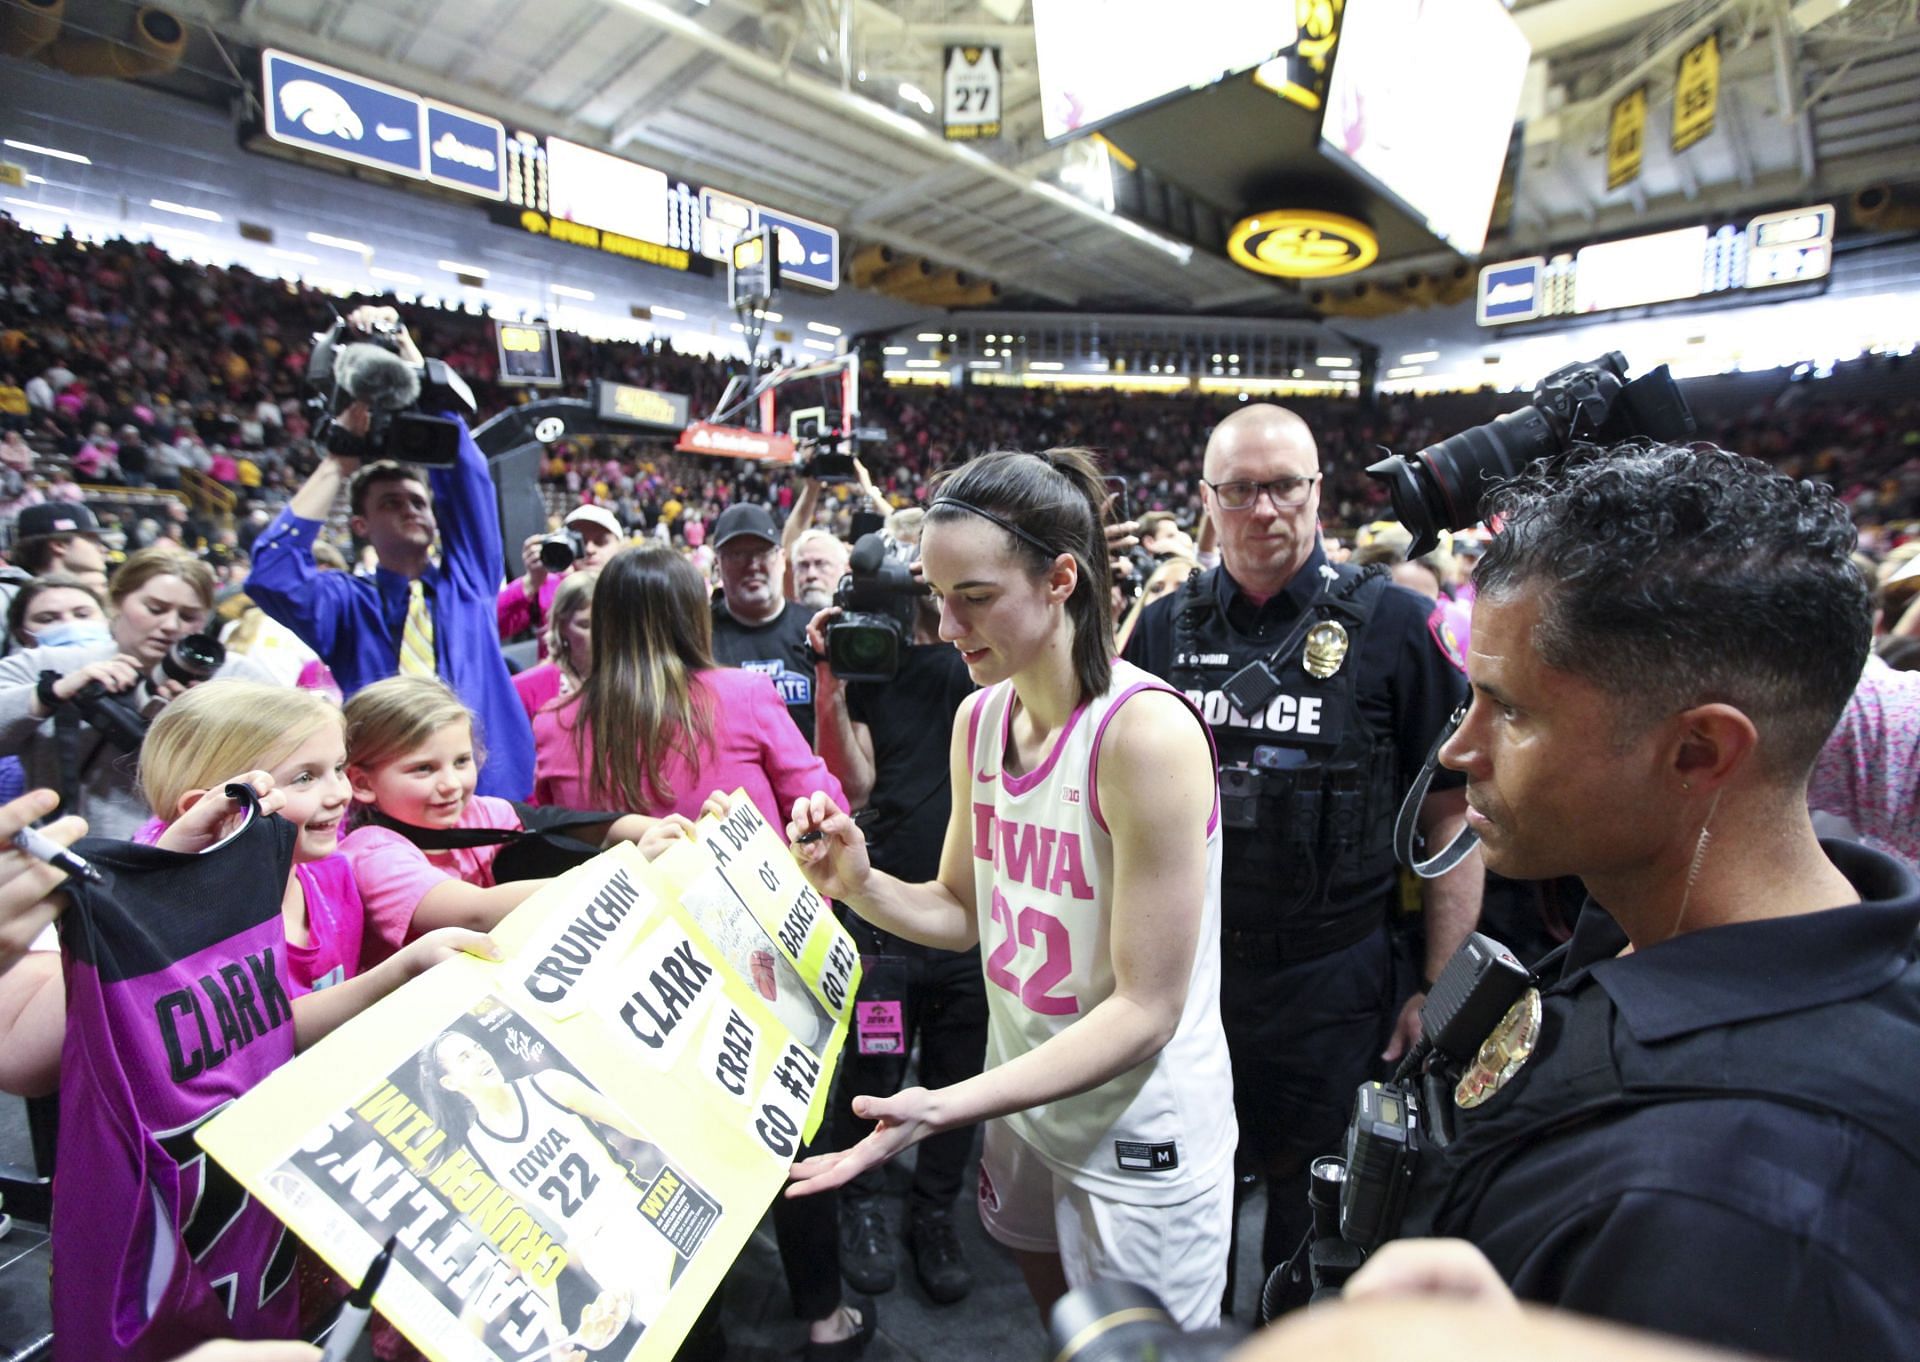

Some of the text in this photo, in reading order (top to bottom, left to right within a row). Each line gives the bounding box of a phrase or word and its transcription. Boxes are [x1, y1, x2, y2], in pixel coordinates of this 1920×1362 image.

[956, 87, 990, 111] 27
[706, 803, 763, 868] A BOWL
[758, 860, 781, 892] OF
[973, 802, 1095, 900] IWA
[523, 868, 640, 1003] CRUNCHIN'
[778, 885, 820, 960] BASKETS
[986, 885, 1079, 1016] 22
[619, 940, 713, 1049] CLARK
[822, 936, 855, 1011] GO #22
[154, 947, 293, 1084] CLARK
[716, 1009, 754, 1096] CRAZY
[352, 1078, 447, 1169] TIM
[755, 1044, 820, 1158] GO #22
[509, 1127, 571, 1188] IOWA
[538, 1152, 601, 1219] 22
[640, 1170, 680, 1220] WIN
[1157, 1150, 1170, 1163] M
[428, 1144, 569, 1289] CRUNCH
